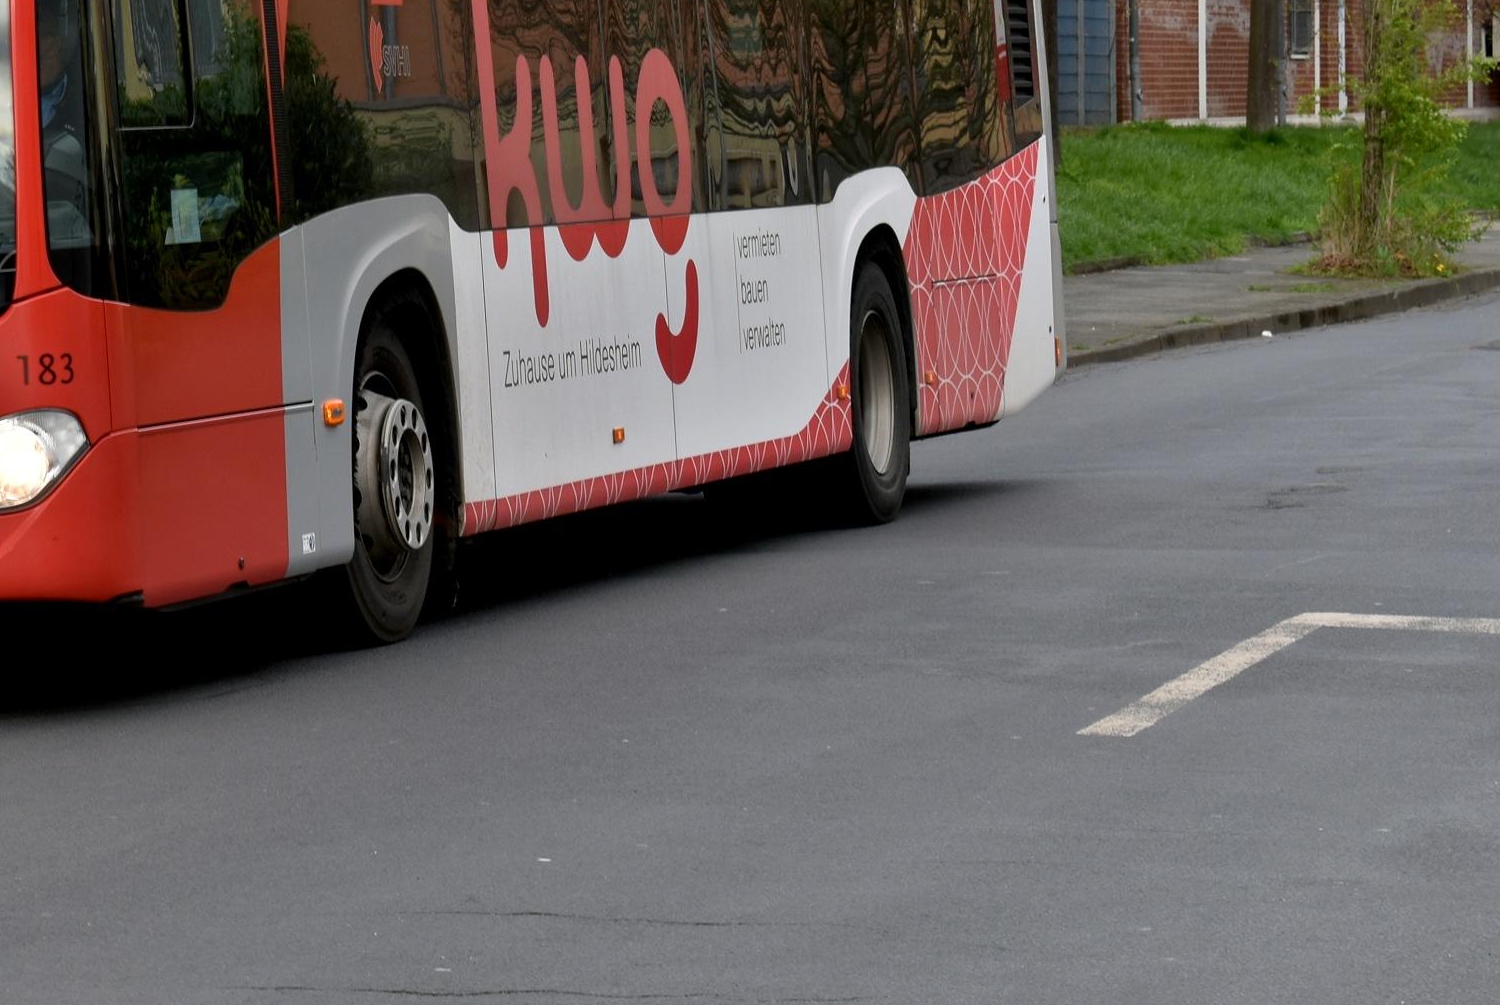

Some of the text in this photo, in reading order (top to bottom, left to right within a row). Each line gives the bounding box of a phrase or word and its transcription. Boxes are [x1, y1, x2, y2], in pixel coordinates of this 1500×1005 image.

[737, 227, 781, 259] vermieten
[740, 274, 769, 305] bauen
[743, 317, 786, 350] verwalten
[16, 352, 75, 386] 183
[503, 334, 642, 388] Zuhause um Hildesheim
